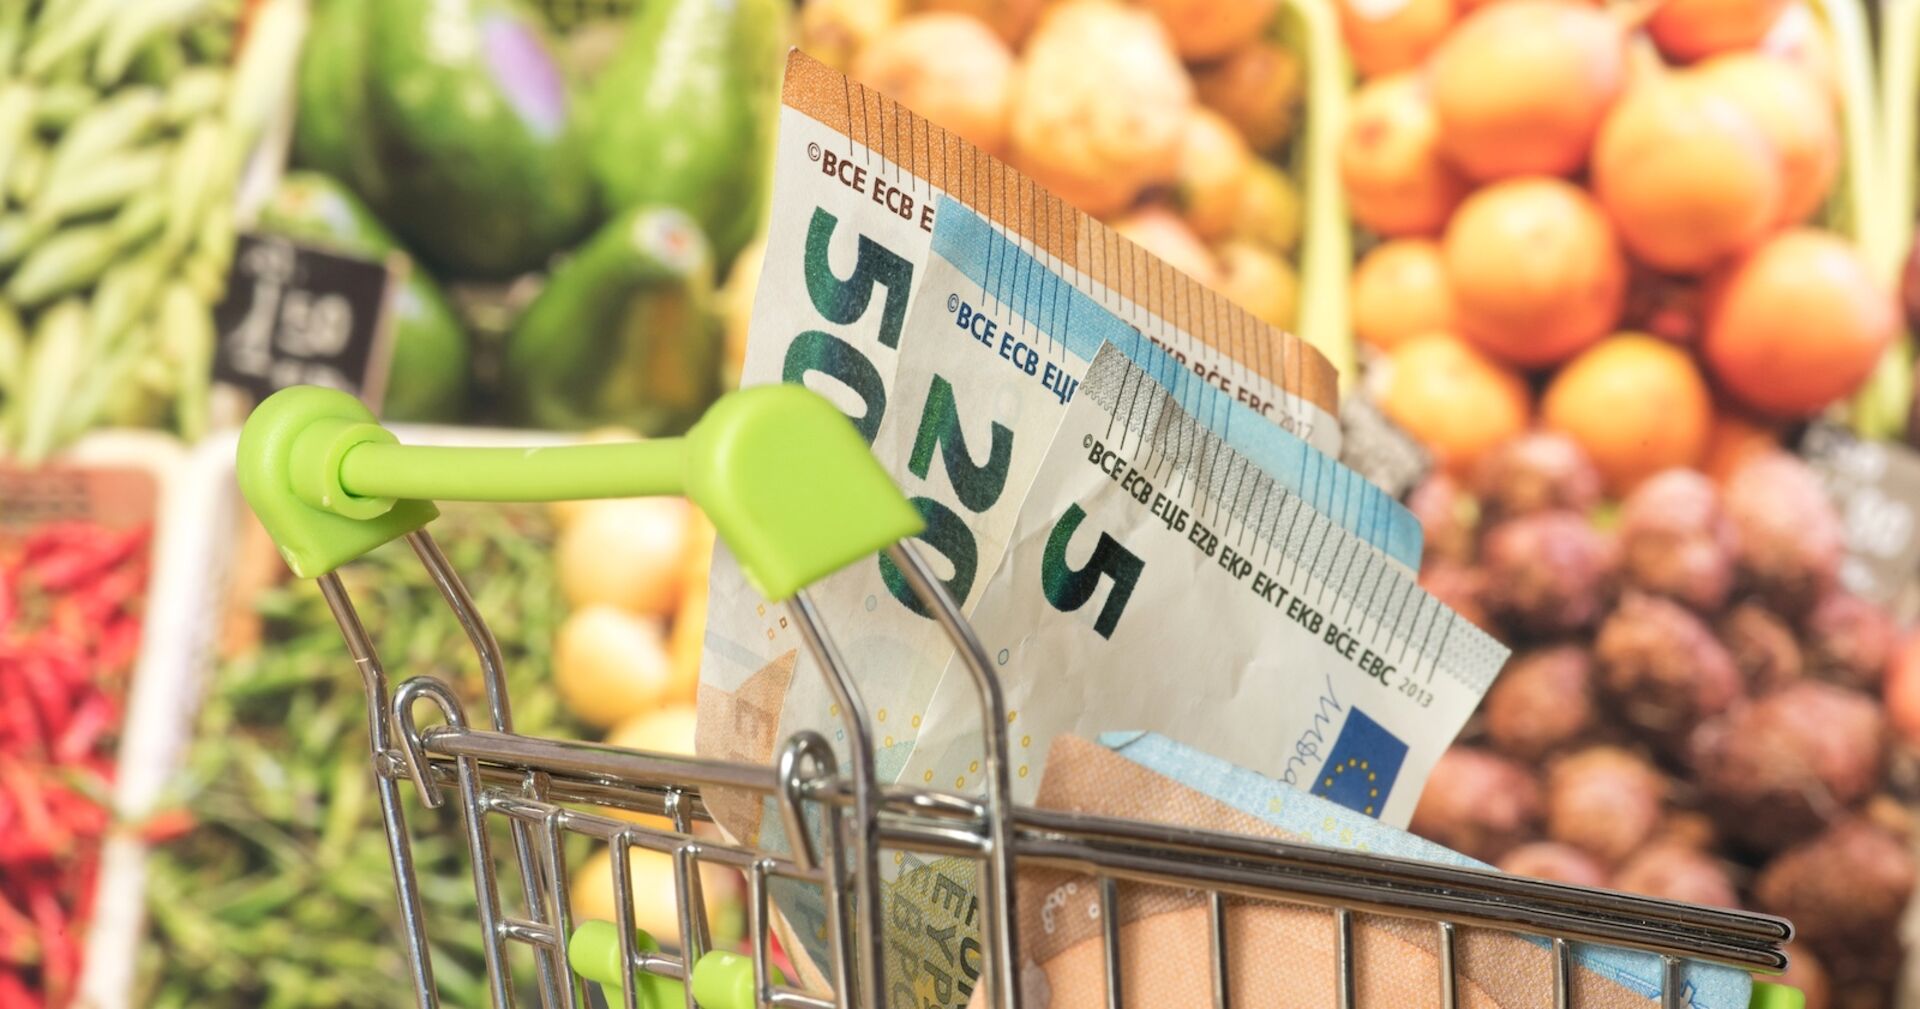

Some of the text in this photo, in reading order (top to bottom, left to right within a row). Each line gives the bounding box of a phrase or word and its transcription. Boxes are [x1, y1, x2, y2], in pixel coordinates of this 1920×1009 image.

[872, 178, 914, 221] ECB
[783, 206, 914, 449] 50
[998, 331, 1039, 377] ECB
[879, 373, 1014, 619] 20
[1041, 502, 1146, 640] 5
[1120, 468, 1153, 505] ECB
[1187, 520, 1219, 558] EZB
[1217, 544, 1253, 580] EKP
[1251, 571, 1289, 608] EKT
[1286, 596, 1324, 635] EKB
[1357, 649, 1397, 687] EBC
[1397, 676, 1435, 709] 2013
